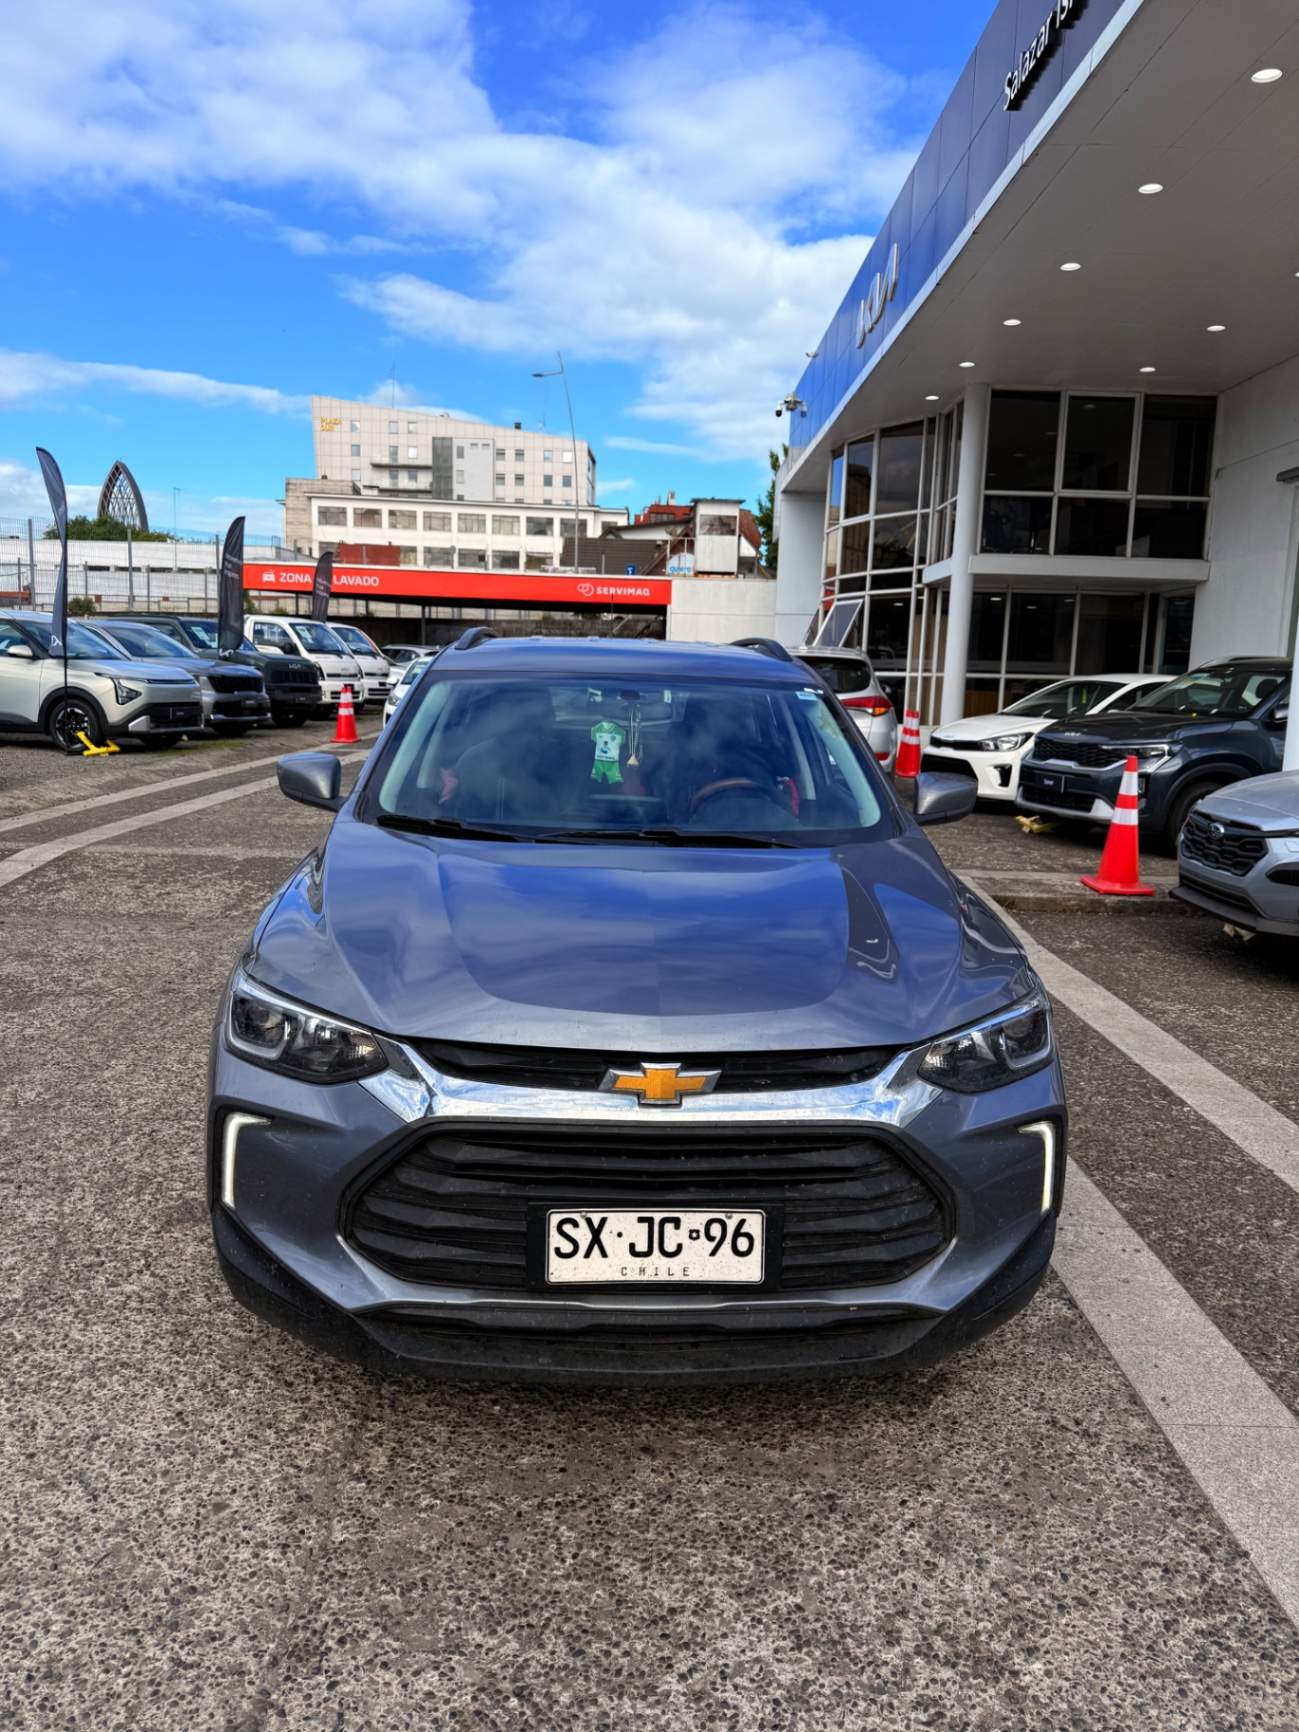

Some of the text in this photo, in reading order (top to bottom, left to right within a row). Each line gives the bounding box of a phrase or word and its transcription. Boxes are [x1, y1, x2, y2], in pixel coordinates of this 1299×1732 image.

[1003, 0, 1074, 111] Salazar Is
[279, 572, 313, 584] ZONA
[333, 575, 380, 587] LAVADO
[620, 1266, 690, 1277] CHILE
